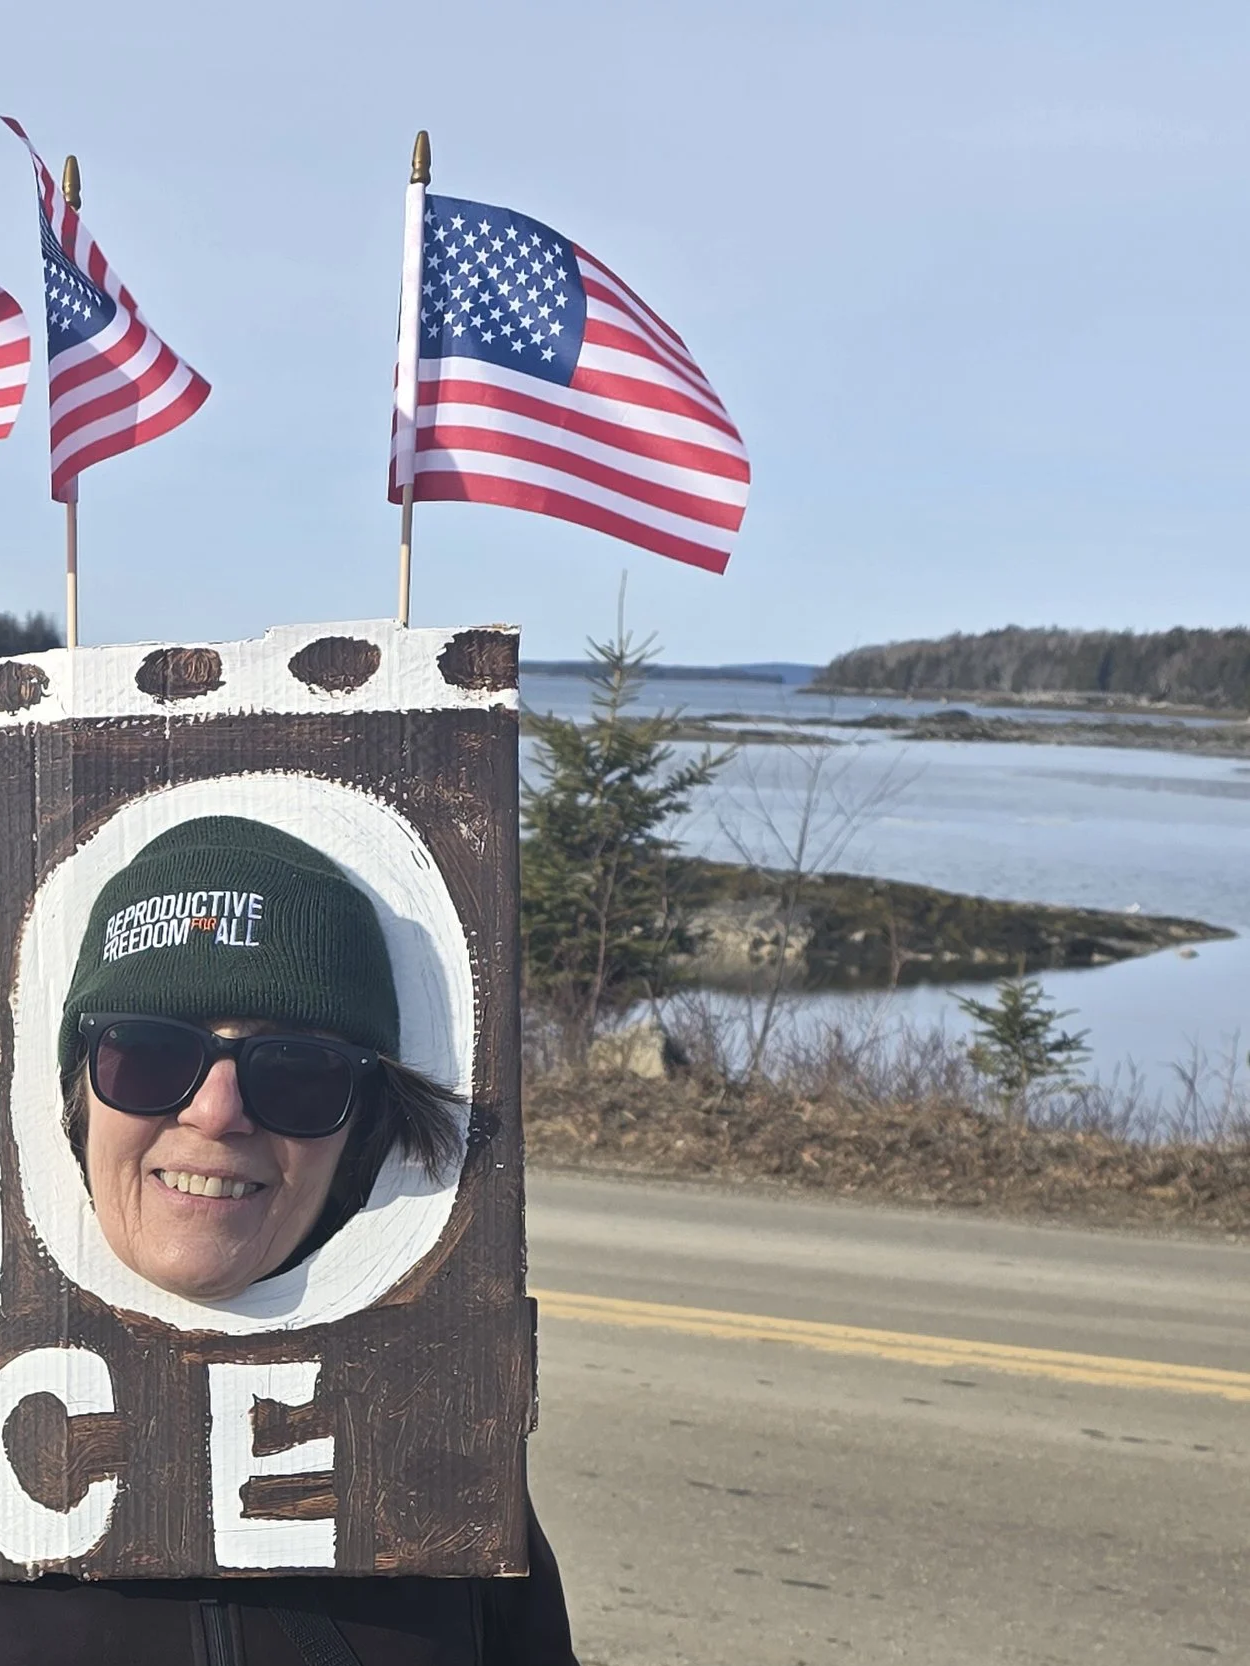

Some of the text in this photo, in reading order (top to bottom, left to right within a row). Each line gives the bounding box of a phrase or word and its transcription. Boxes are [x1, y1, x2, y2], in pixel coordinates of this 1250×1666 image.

[103, 917, 260, 962] FREEDOM FOR ALL
[104, 891, 264, 944] REPRODUCTIVE
